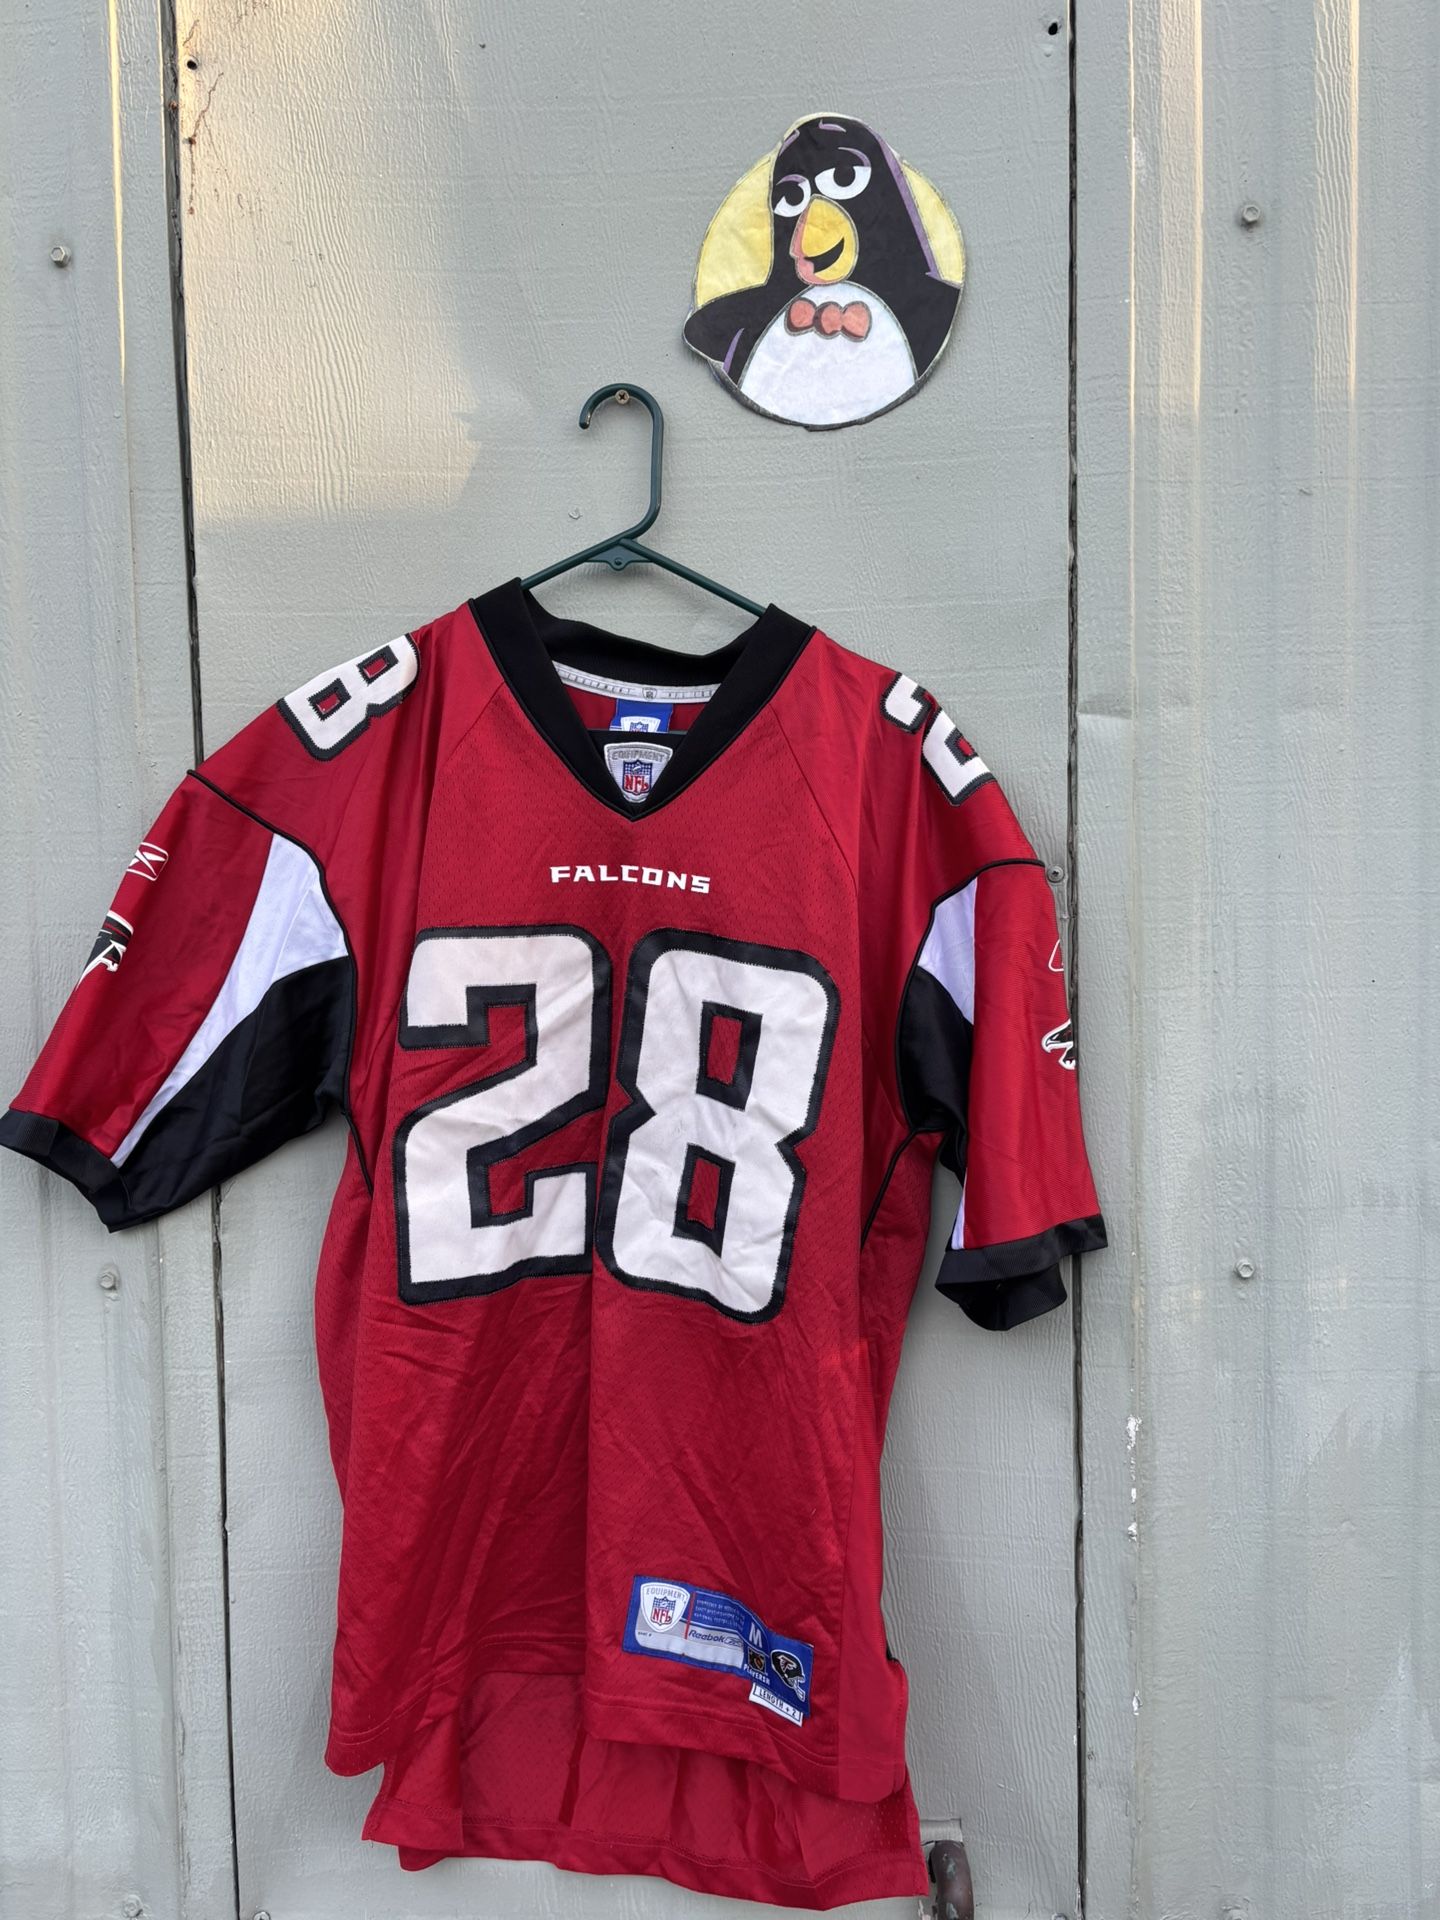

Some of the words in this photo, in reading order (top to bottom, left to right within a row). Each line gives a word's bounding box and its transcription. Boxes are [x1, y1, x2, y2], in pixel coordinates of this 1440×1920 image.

[611, 749, 665, 763] EQUIPMENT
[623, 773, 650, 794] NFL
[550, 864, 711, 894] FALCONS
[392, 924, 841, 1326] 28
[646, 1587, 686, 1602] EQUIPMENT
[651, 1608, 673, 1625] NFL
[688, 1629, 725, 1643] Reebok
[748, 1621, 764, 1649] M
[759, 1687, 784, 1710] LENGTH
